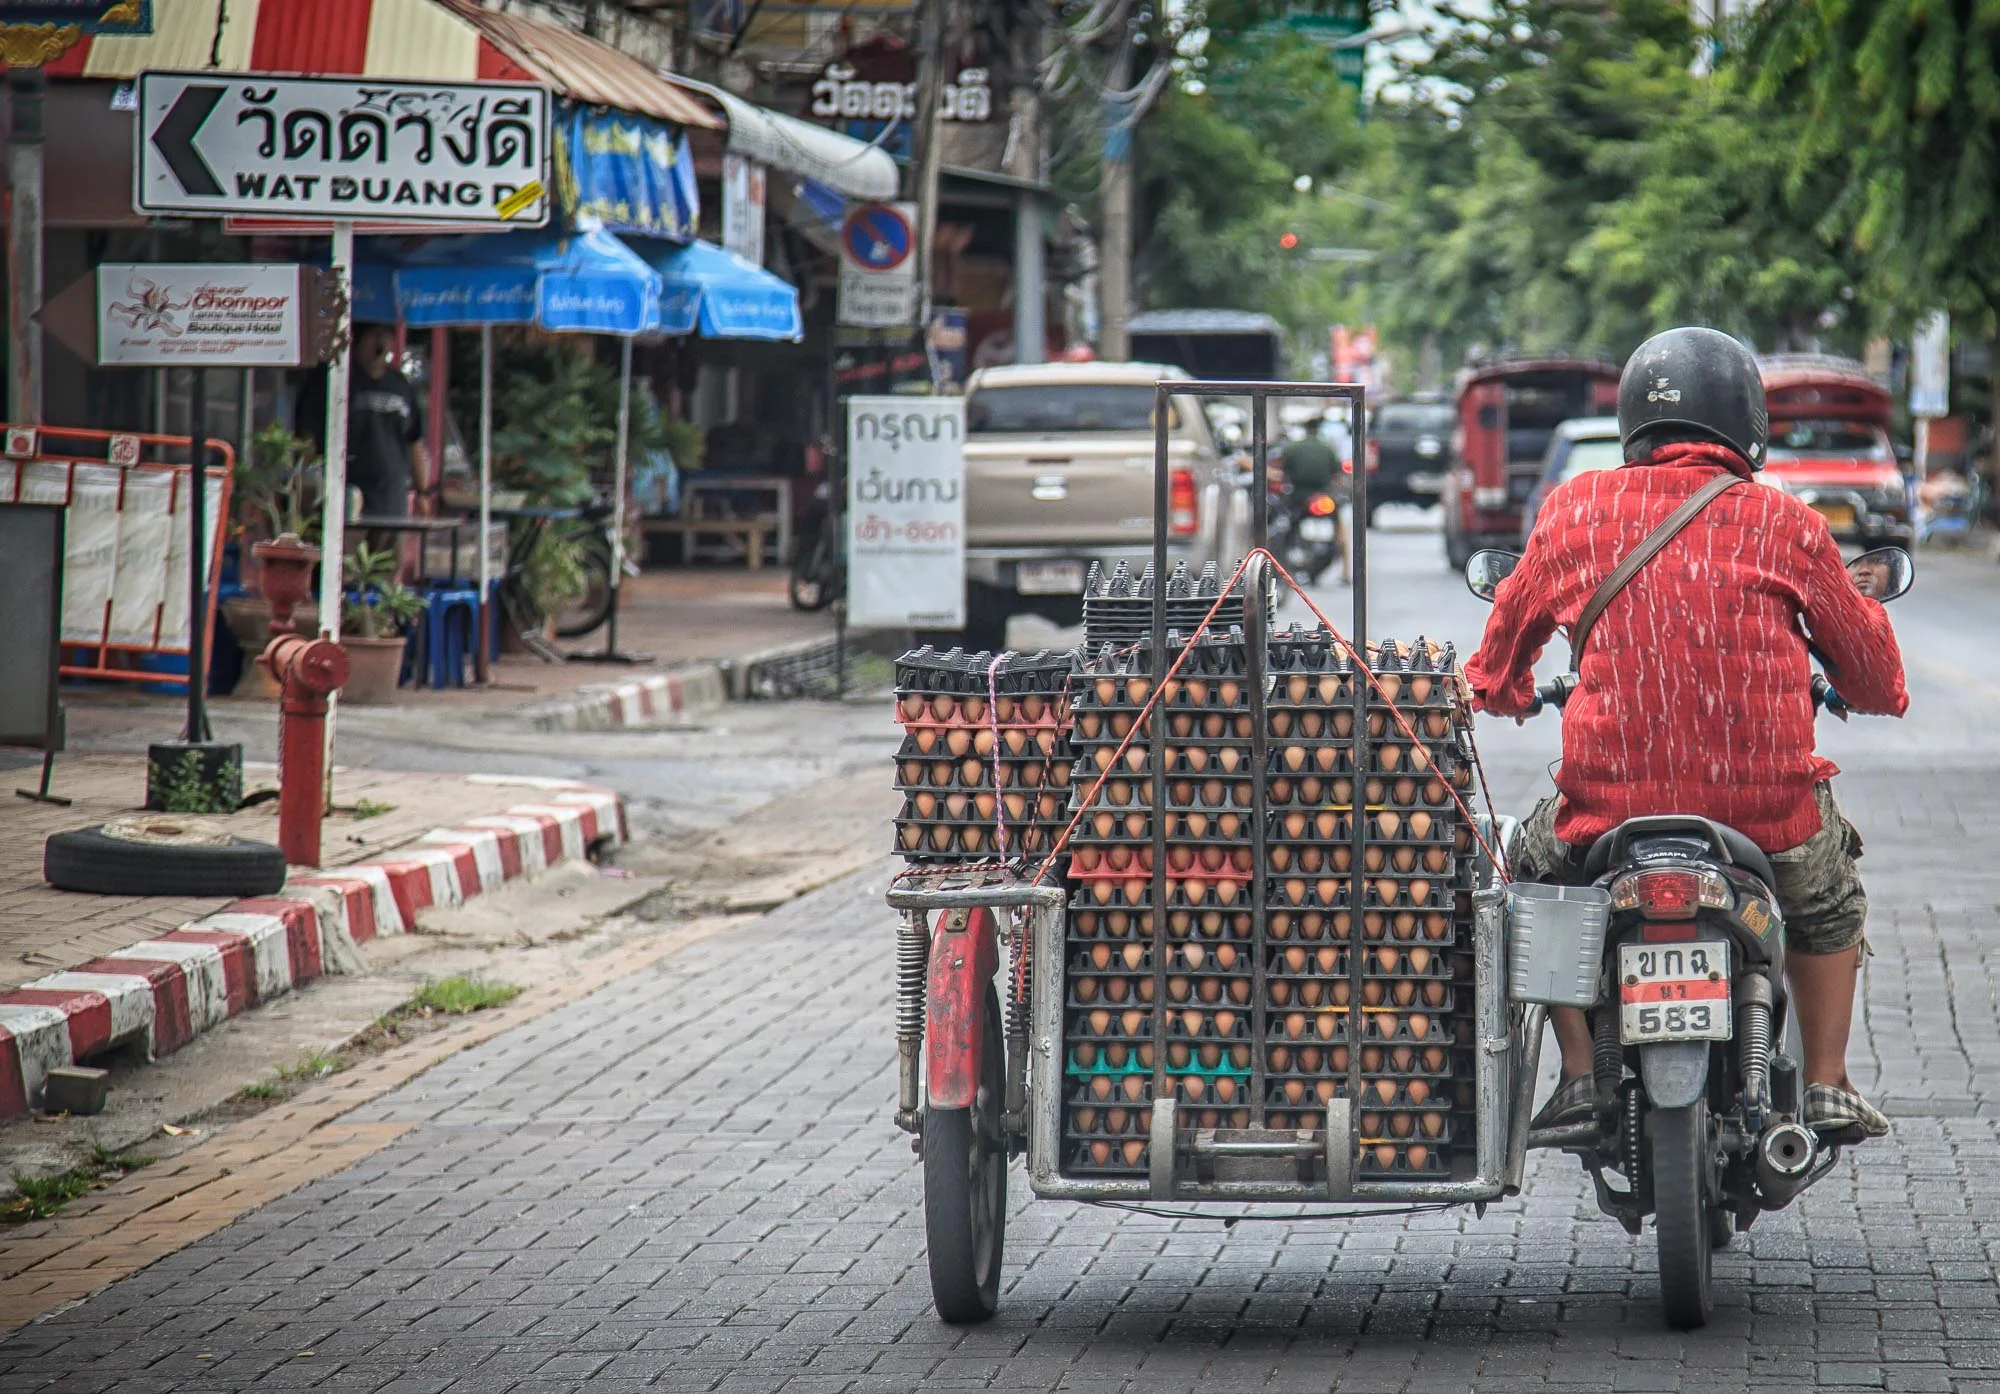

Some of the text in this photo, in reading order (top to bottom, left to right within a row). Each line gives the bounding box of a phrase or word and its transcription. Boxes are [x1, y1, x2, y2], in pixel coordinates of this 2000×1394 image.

[237, 86, 532, 168] วัดดวงดี
[236, 173, 320, 199] WAT
[331, 174, 482, 206] DUANG
[192, 293, 290, 312] Chompor
[856, 412, 958, 452] กรุณา
[856, 467, 958, 504] เว้นทาง
[855, 513, 957, 543] เข้า-ออก
[1638, 1005, 1711, 1034] 583
